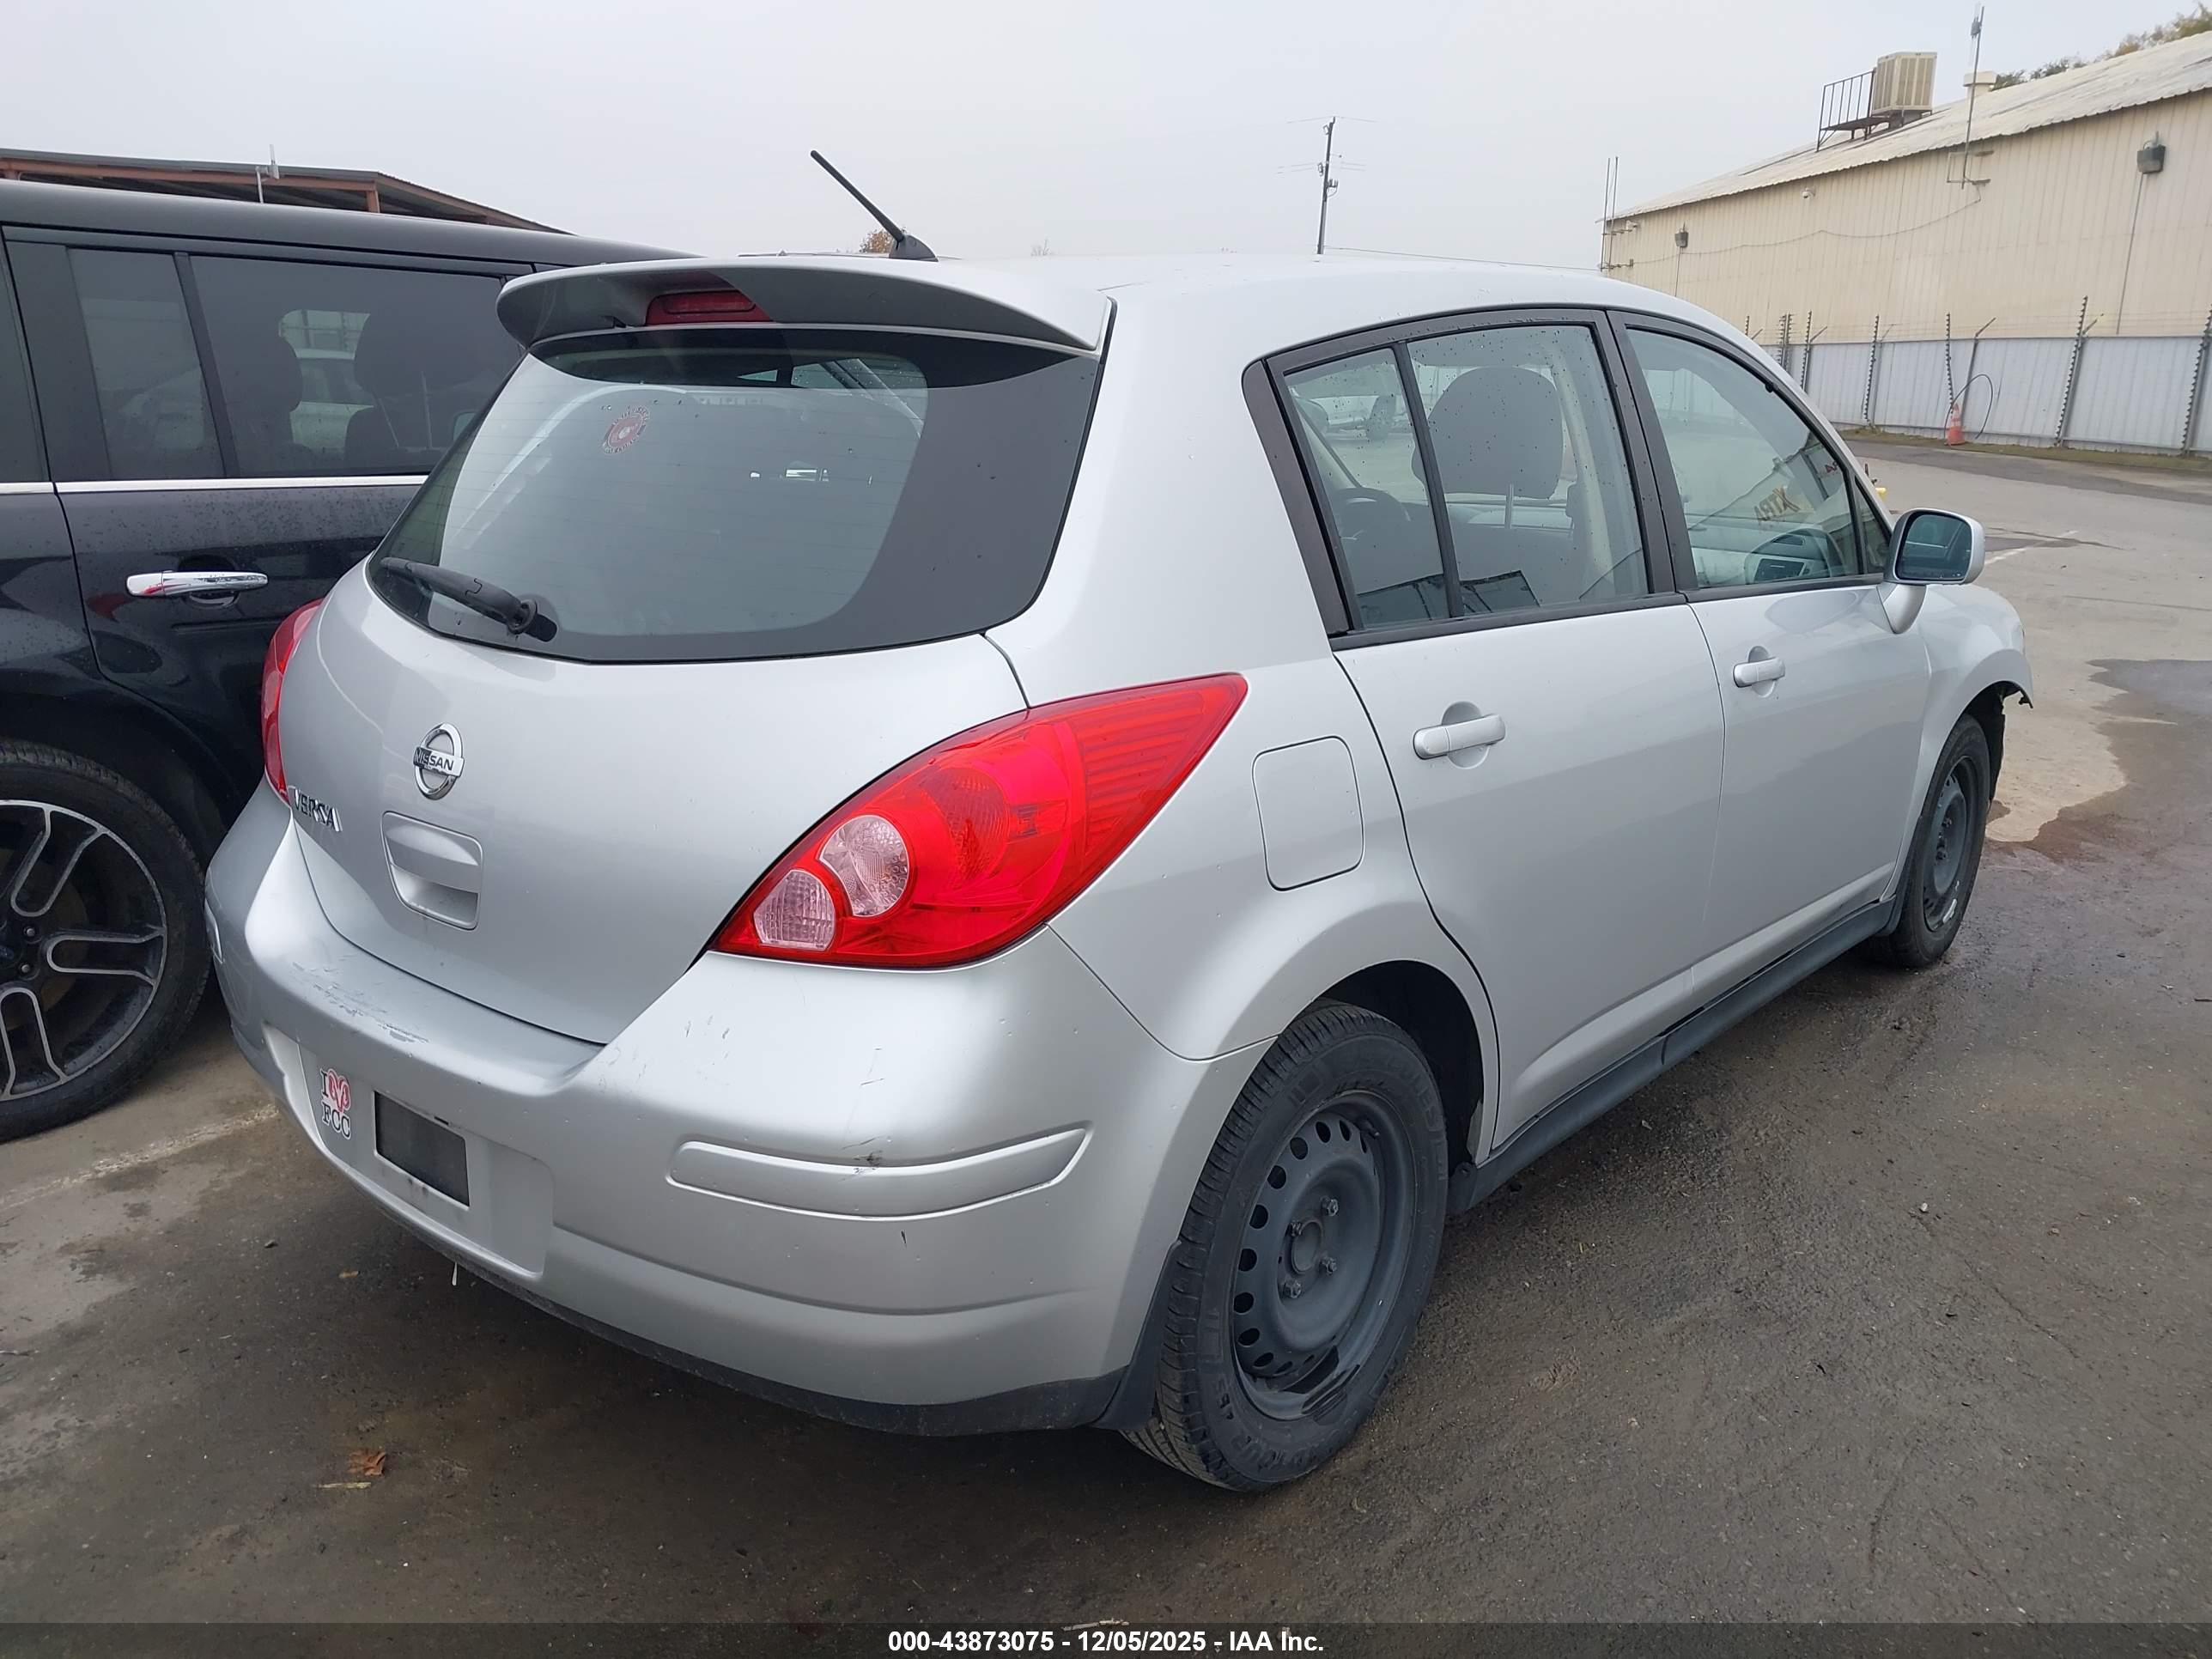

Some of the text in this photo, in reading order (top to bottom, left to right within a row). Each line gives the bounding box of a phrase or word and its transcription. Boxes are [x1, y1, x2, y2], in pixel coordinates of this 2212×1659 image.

[415, 748, 454, 771] NISSAN
[294, 788, 343, 832] VERSA
[322, 1102, 350, 1139] FCC
